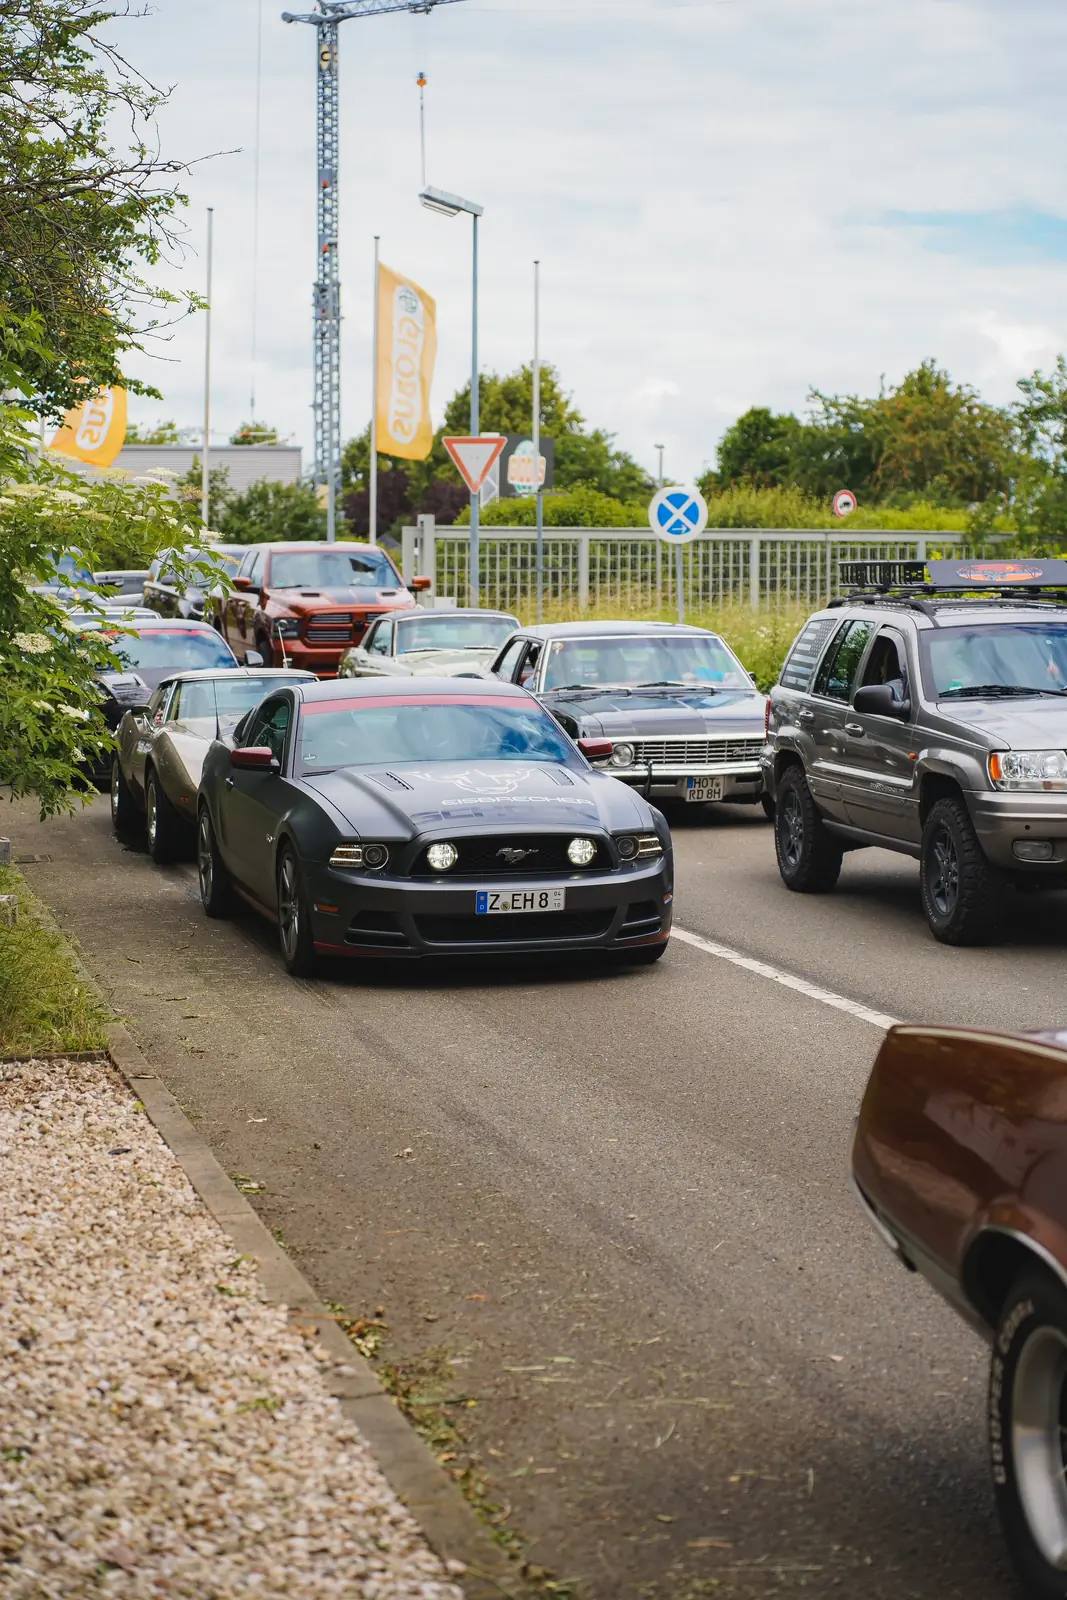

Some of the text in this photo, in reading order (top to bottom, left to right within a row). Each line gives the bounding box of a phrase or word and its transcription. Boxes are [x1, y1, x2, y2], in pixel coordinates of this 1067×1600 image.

[693, 777, 716, 788] HOT
[688, 788, 721, 800] RD 8H
[441, 796, 595, 806] EISBRECHER
[488, 894, 500, 910] Z
[511, 893, 535, 910] EH
[538, 892, 549, 909] 8
